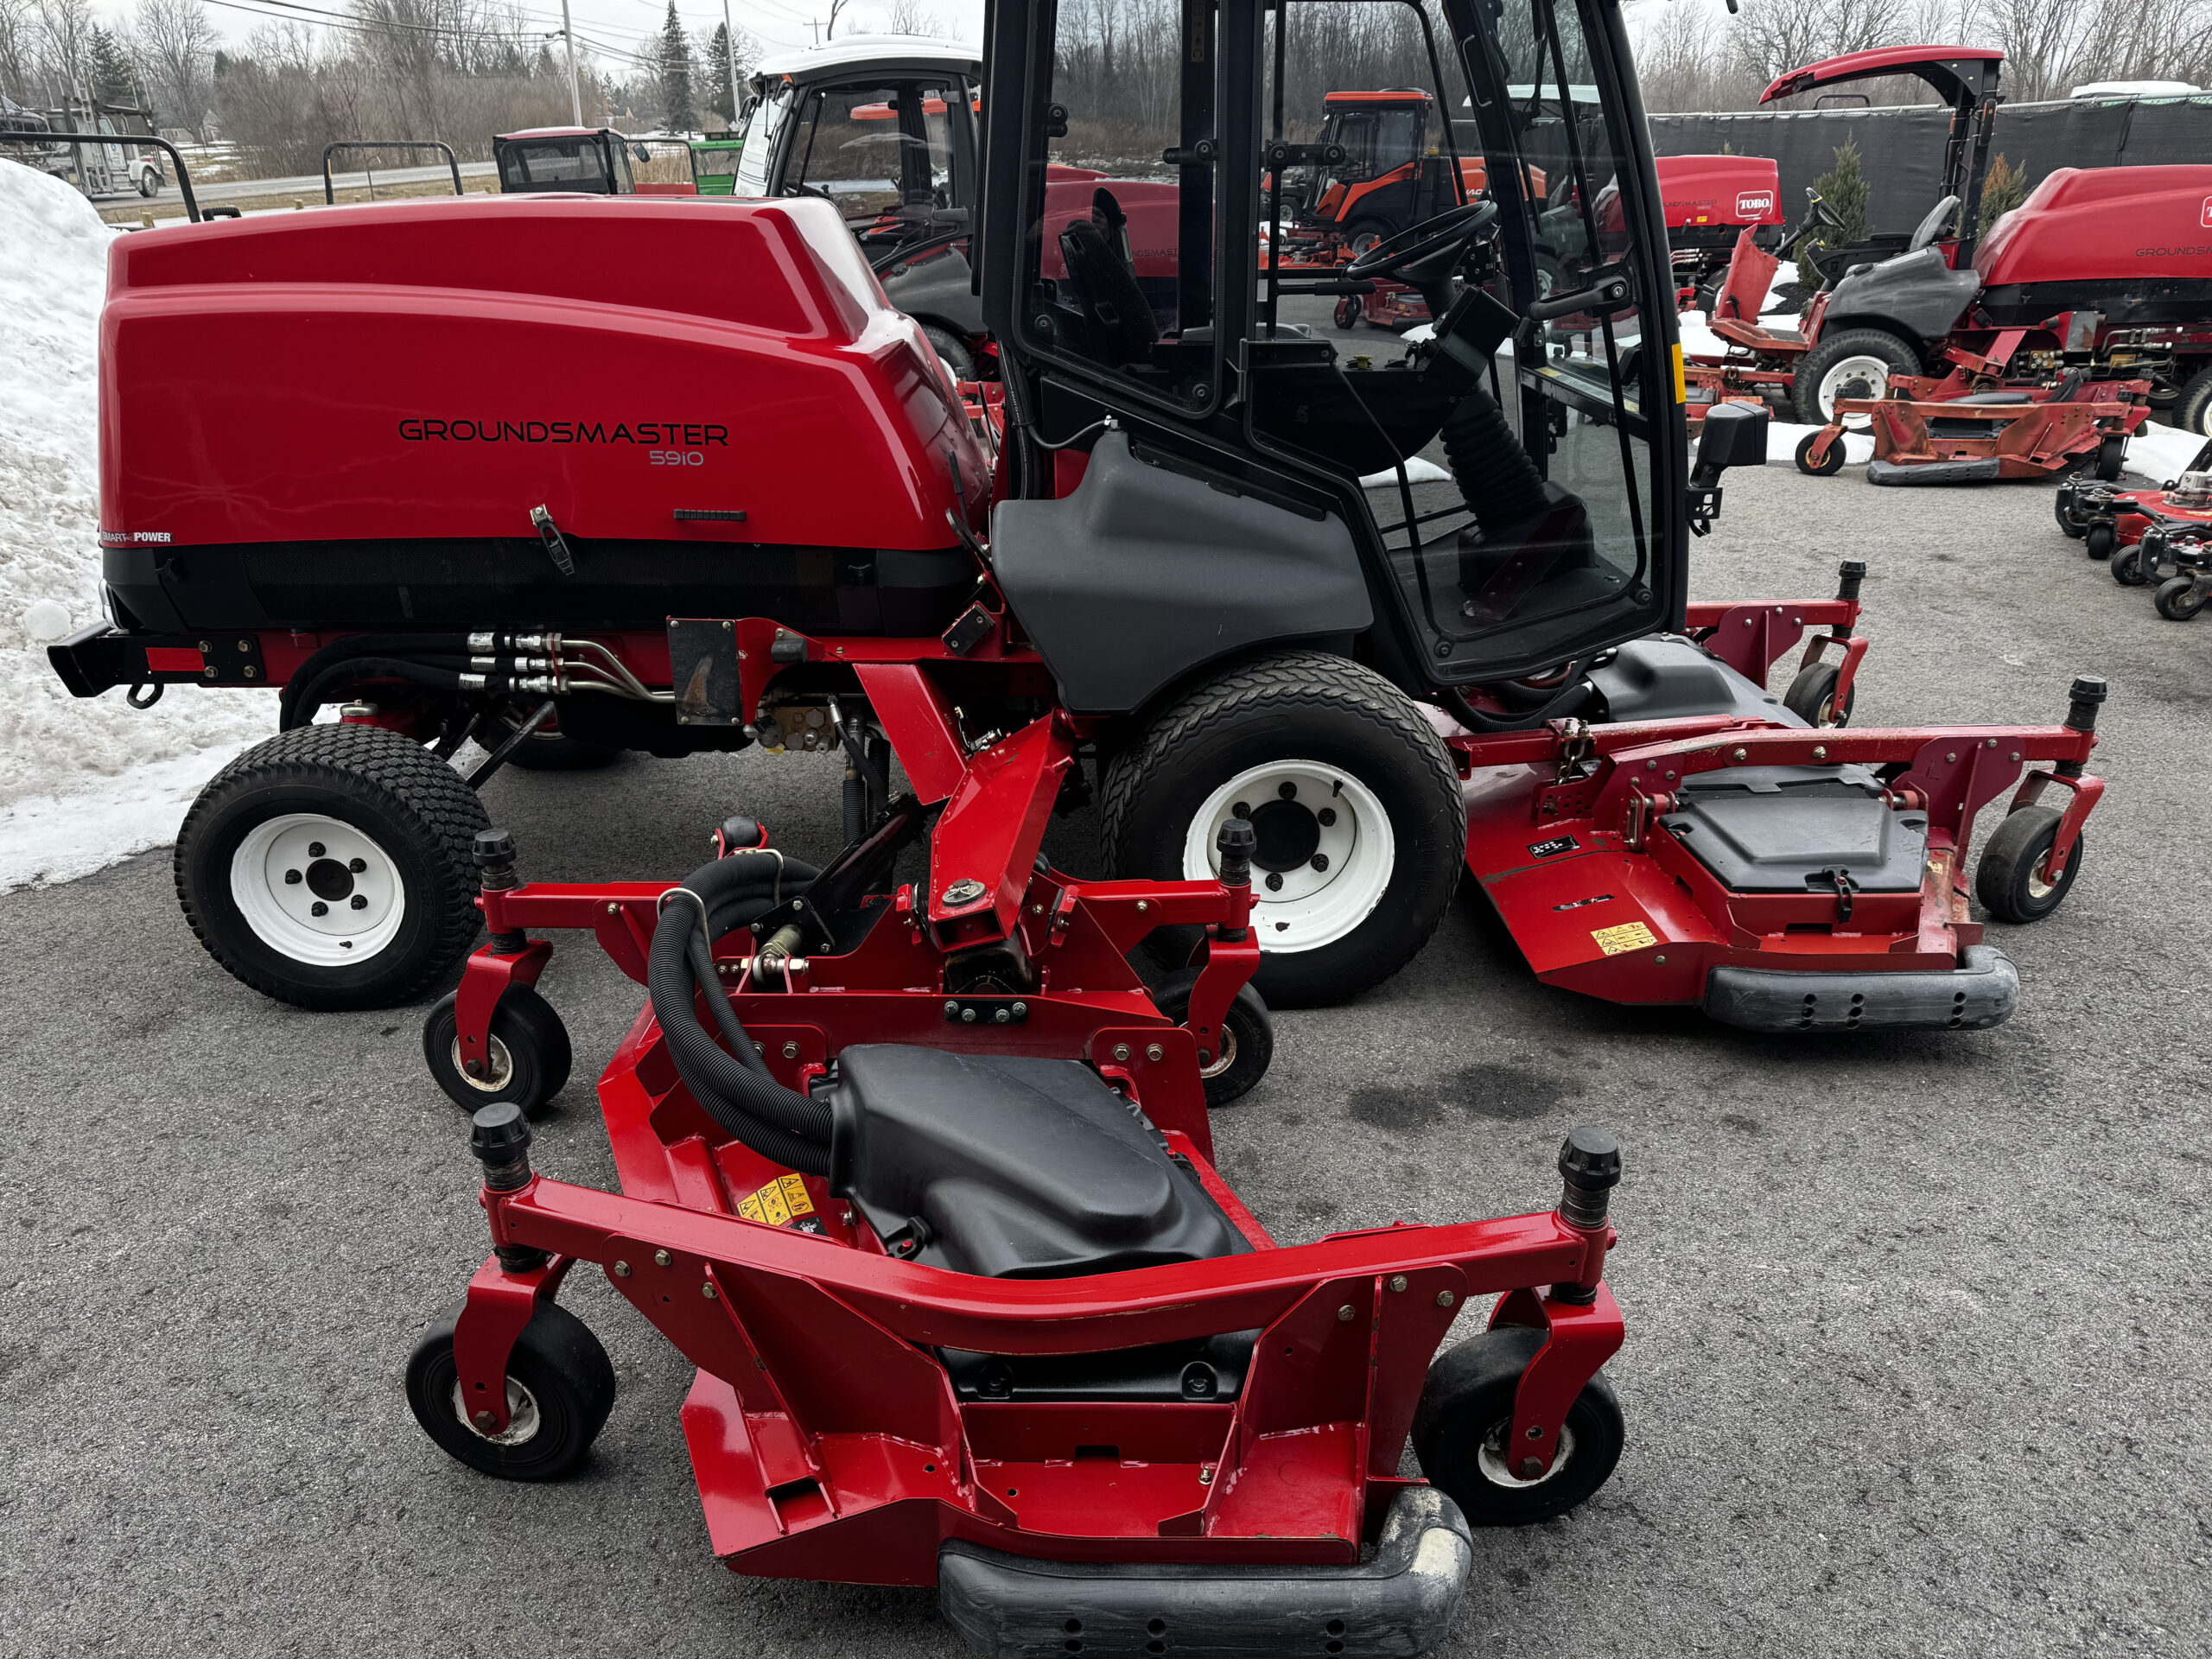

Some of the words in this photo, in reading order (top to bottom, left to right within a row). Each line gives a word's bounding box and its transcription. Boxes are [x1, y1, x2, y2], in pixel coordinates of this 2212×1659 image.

[1739, 198, 1770, 209] TORO
[398, 419, 728, 447] GROUNDSMASTER
[102, 531, 126, 543] SMART
[133, 531, 171, 543] POWER
